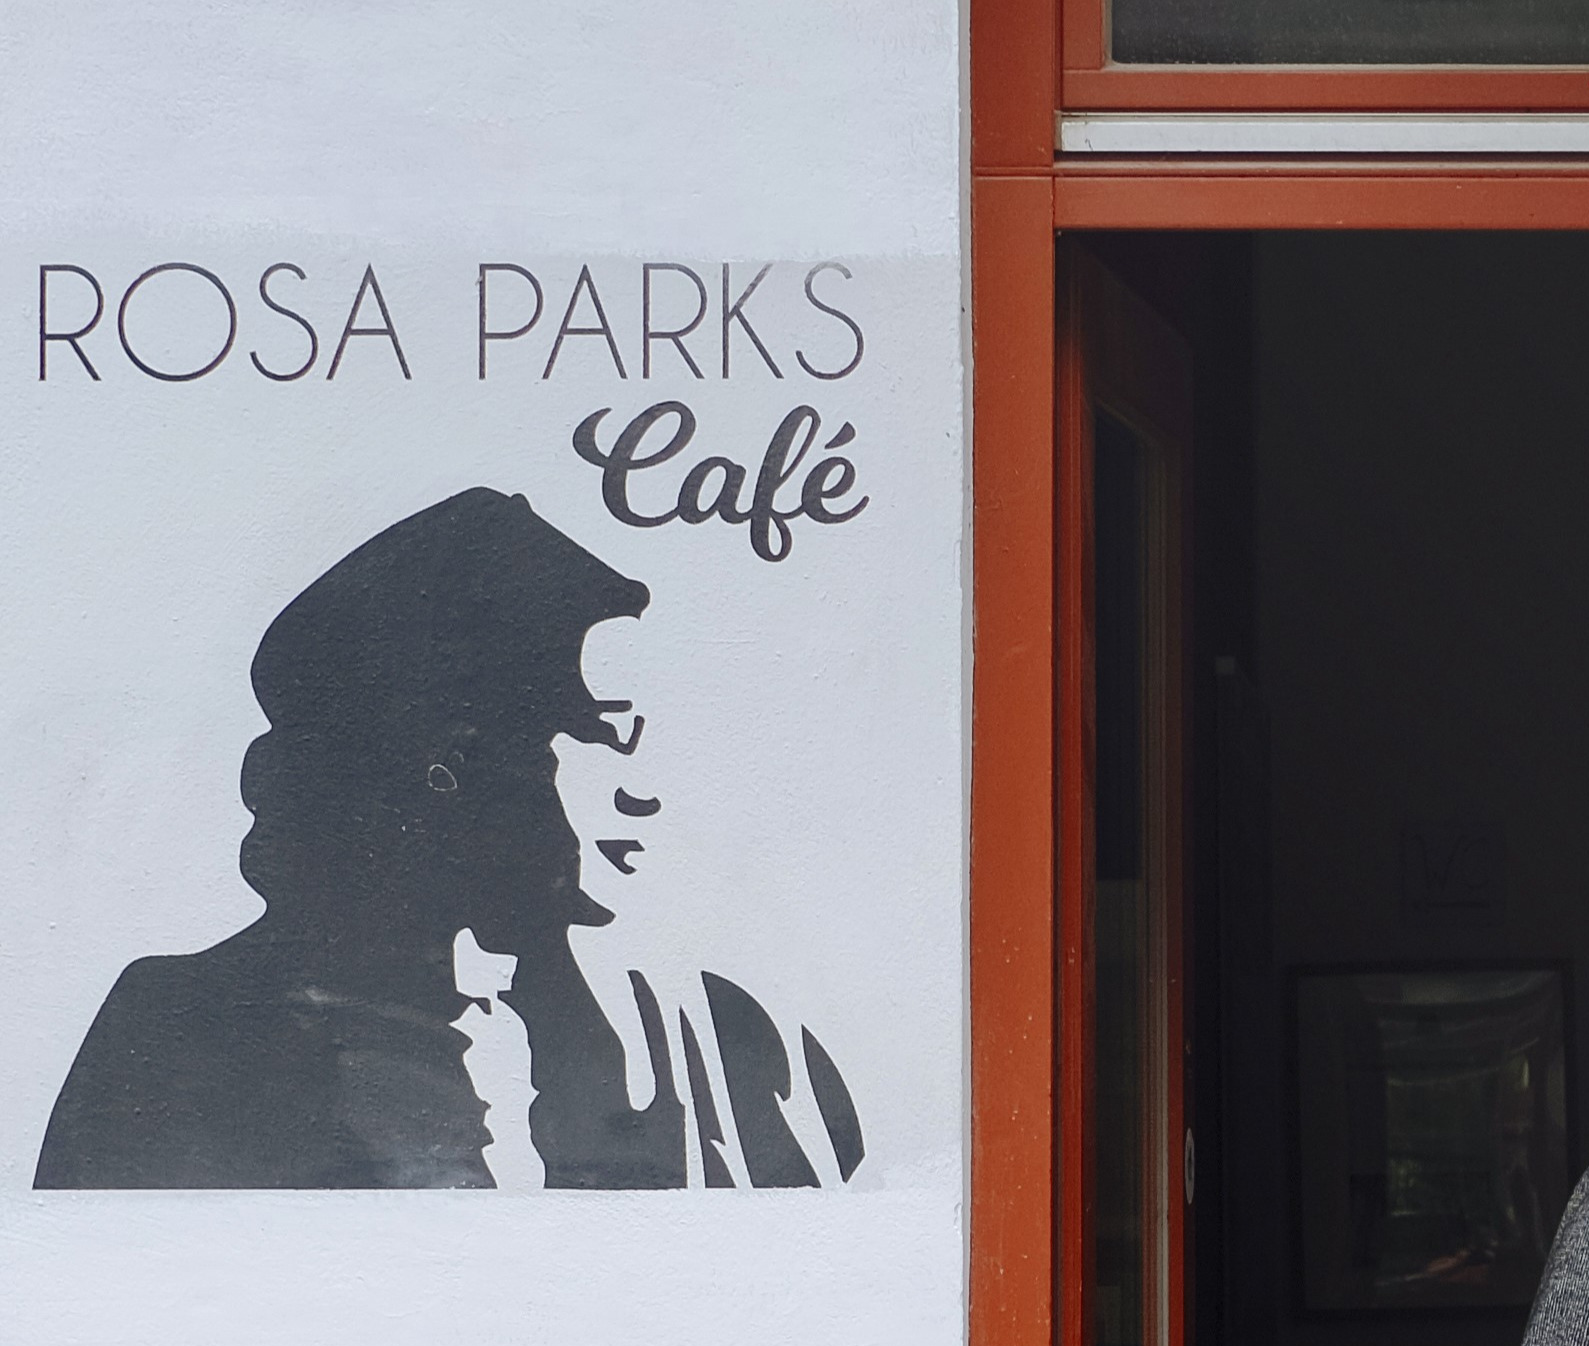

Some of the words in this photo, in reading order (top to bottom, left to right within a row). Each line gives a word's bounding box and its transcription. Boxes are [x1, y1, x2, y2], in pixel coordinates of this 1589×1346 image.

[38, 262, 412, 382] ROSA
[477, 262, 865, 381] PARKS
[571, 400, 870, 563] Café
